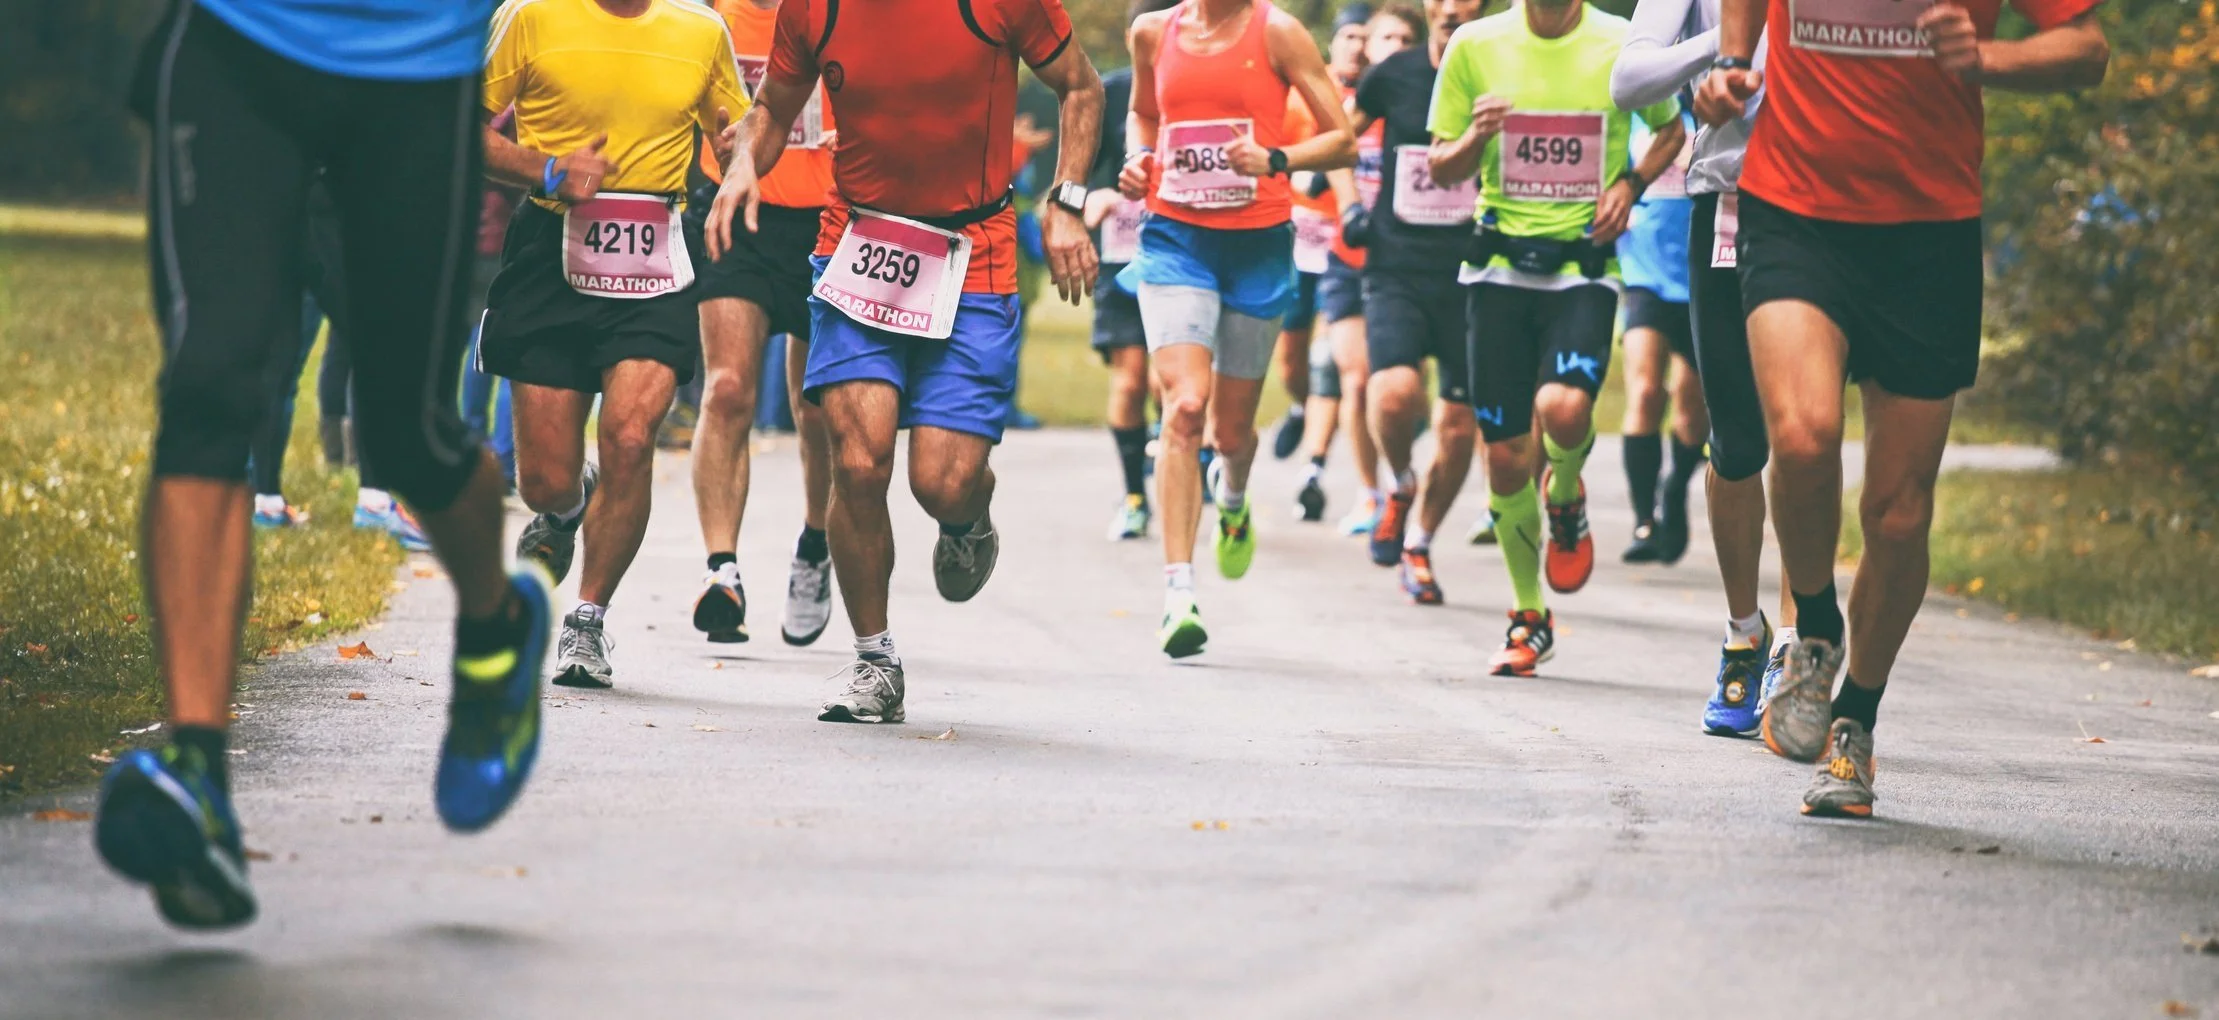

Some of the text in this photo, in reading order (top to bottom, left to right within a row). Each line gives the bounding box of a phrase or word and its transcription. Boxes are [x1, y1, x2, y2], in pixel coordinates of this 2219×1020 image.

[1797, 22, 1931, 46] MARATHON
[1516, 136, 1583, 165] 4599
[1507, 183, 1598, 197] MARATHON
[584, 221, 655, 256] 4219
[851, 243, 920, 288] 3259
[570, 273, 673, 292] MARATHON
[822, 285, 929, 329] MARATHON
